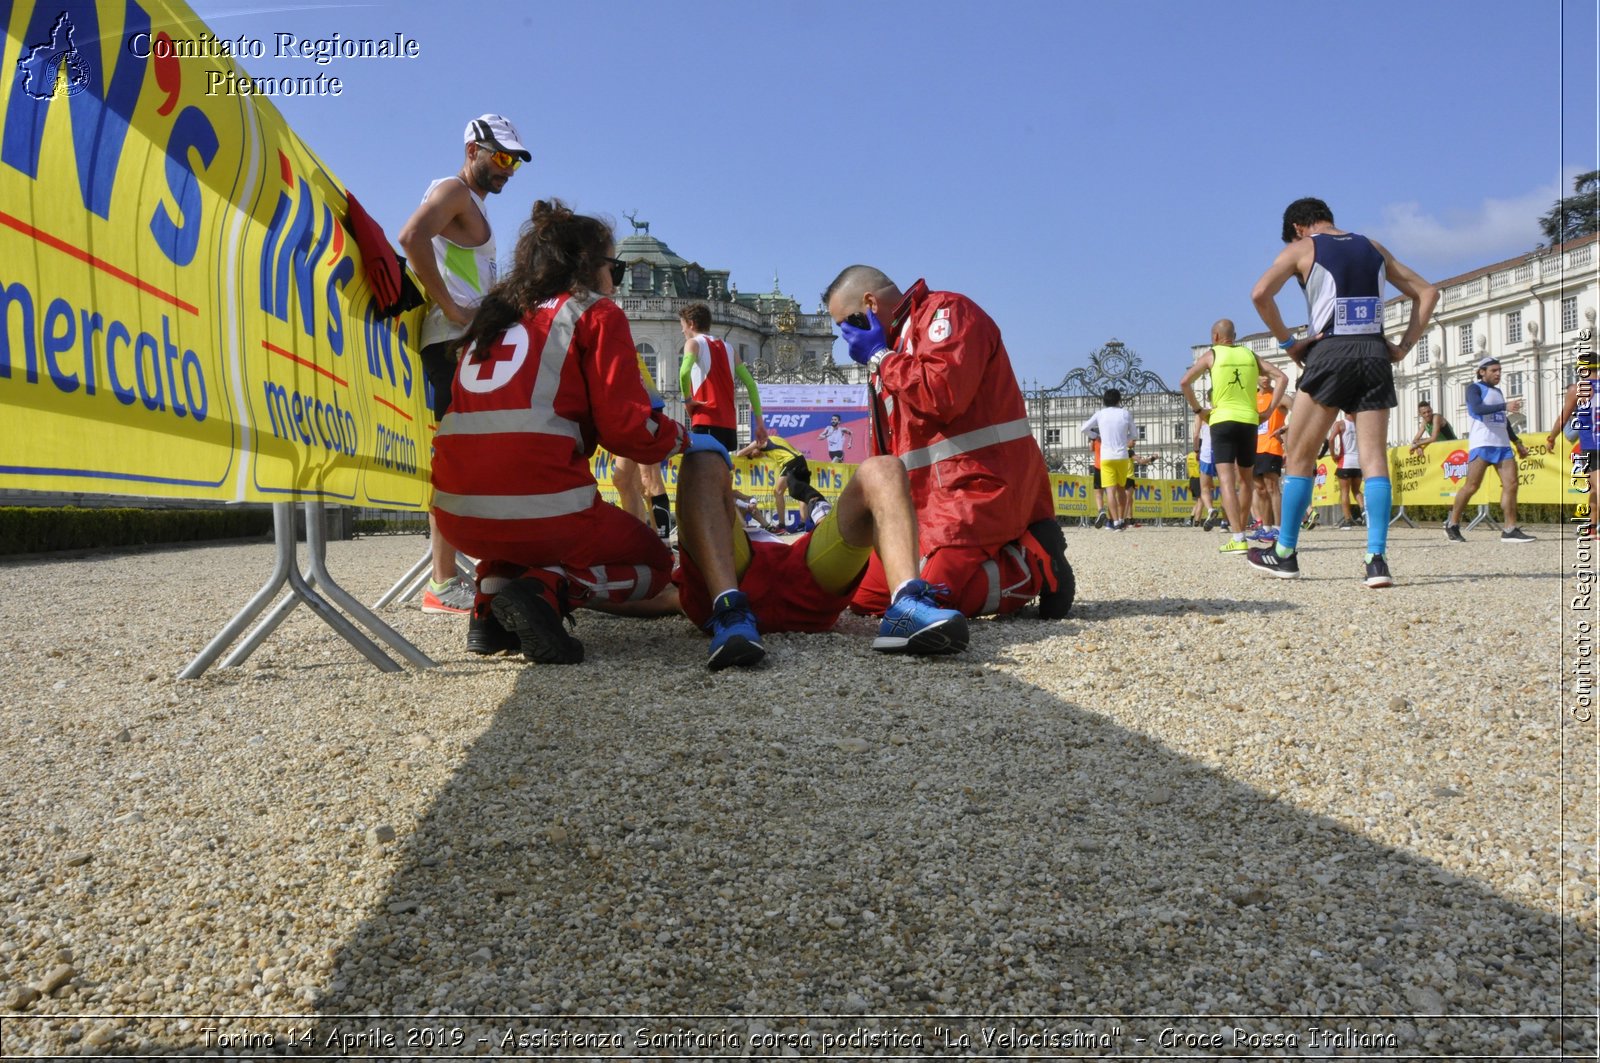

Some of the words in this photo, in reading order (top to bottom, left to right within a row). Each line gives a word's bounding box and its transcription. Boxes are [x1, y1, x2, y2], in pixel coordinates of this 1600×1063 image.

[260, 148, 355, 356] iN's
[1354, 305, 1368, 319] 13
[264, 380, 358, 457] mercato
[374, 422, 418, 475] mercato
[1528, 444, 1547, 456] ESO
[1405, 454, 1427, 467] PRESO
[750, 464, 775, 487] iN's
[817, 467, 842, 488] iN's
[1058, 480, 1087, 498] iN's
[1135, 484, 1162, 501] iN's
[1058, 503, 1088, 511] mercato
